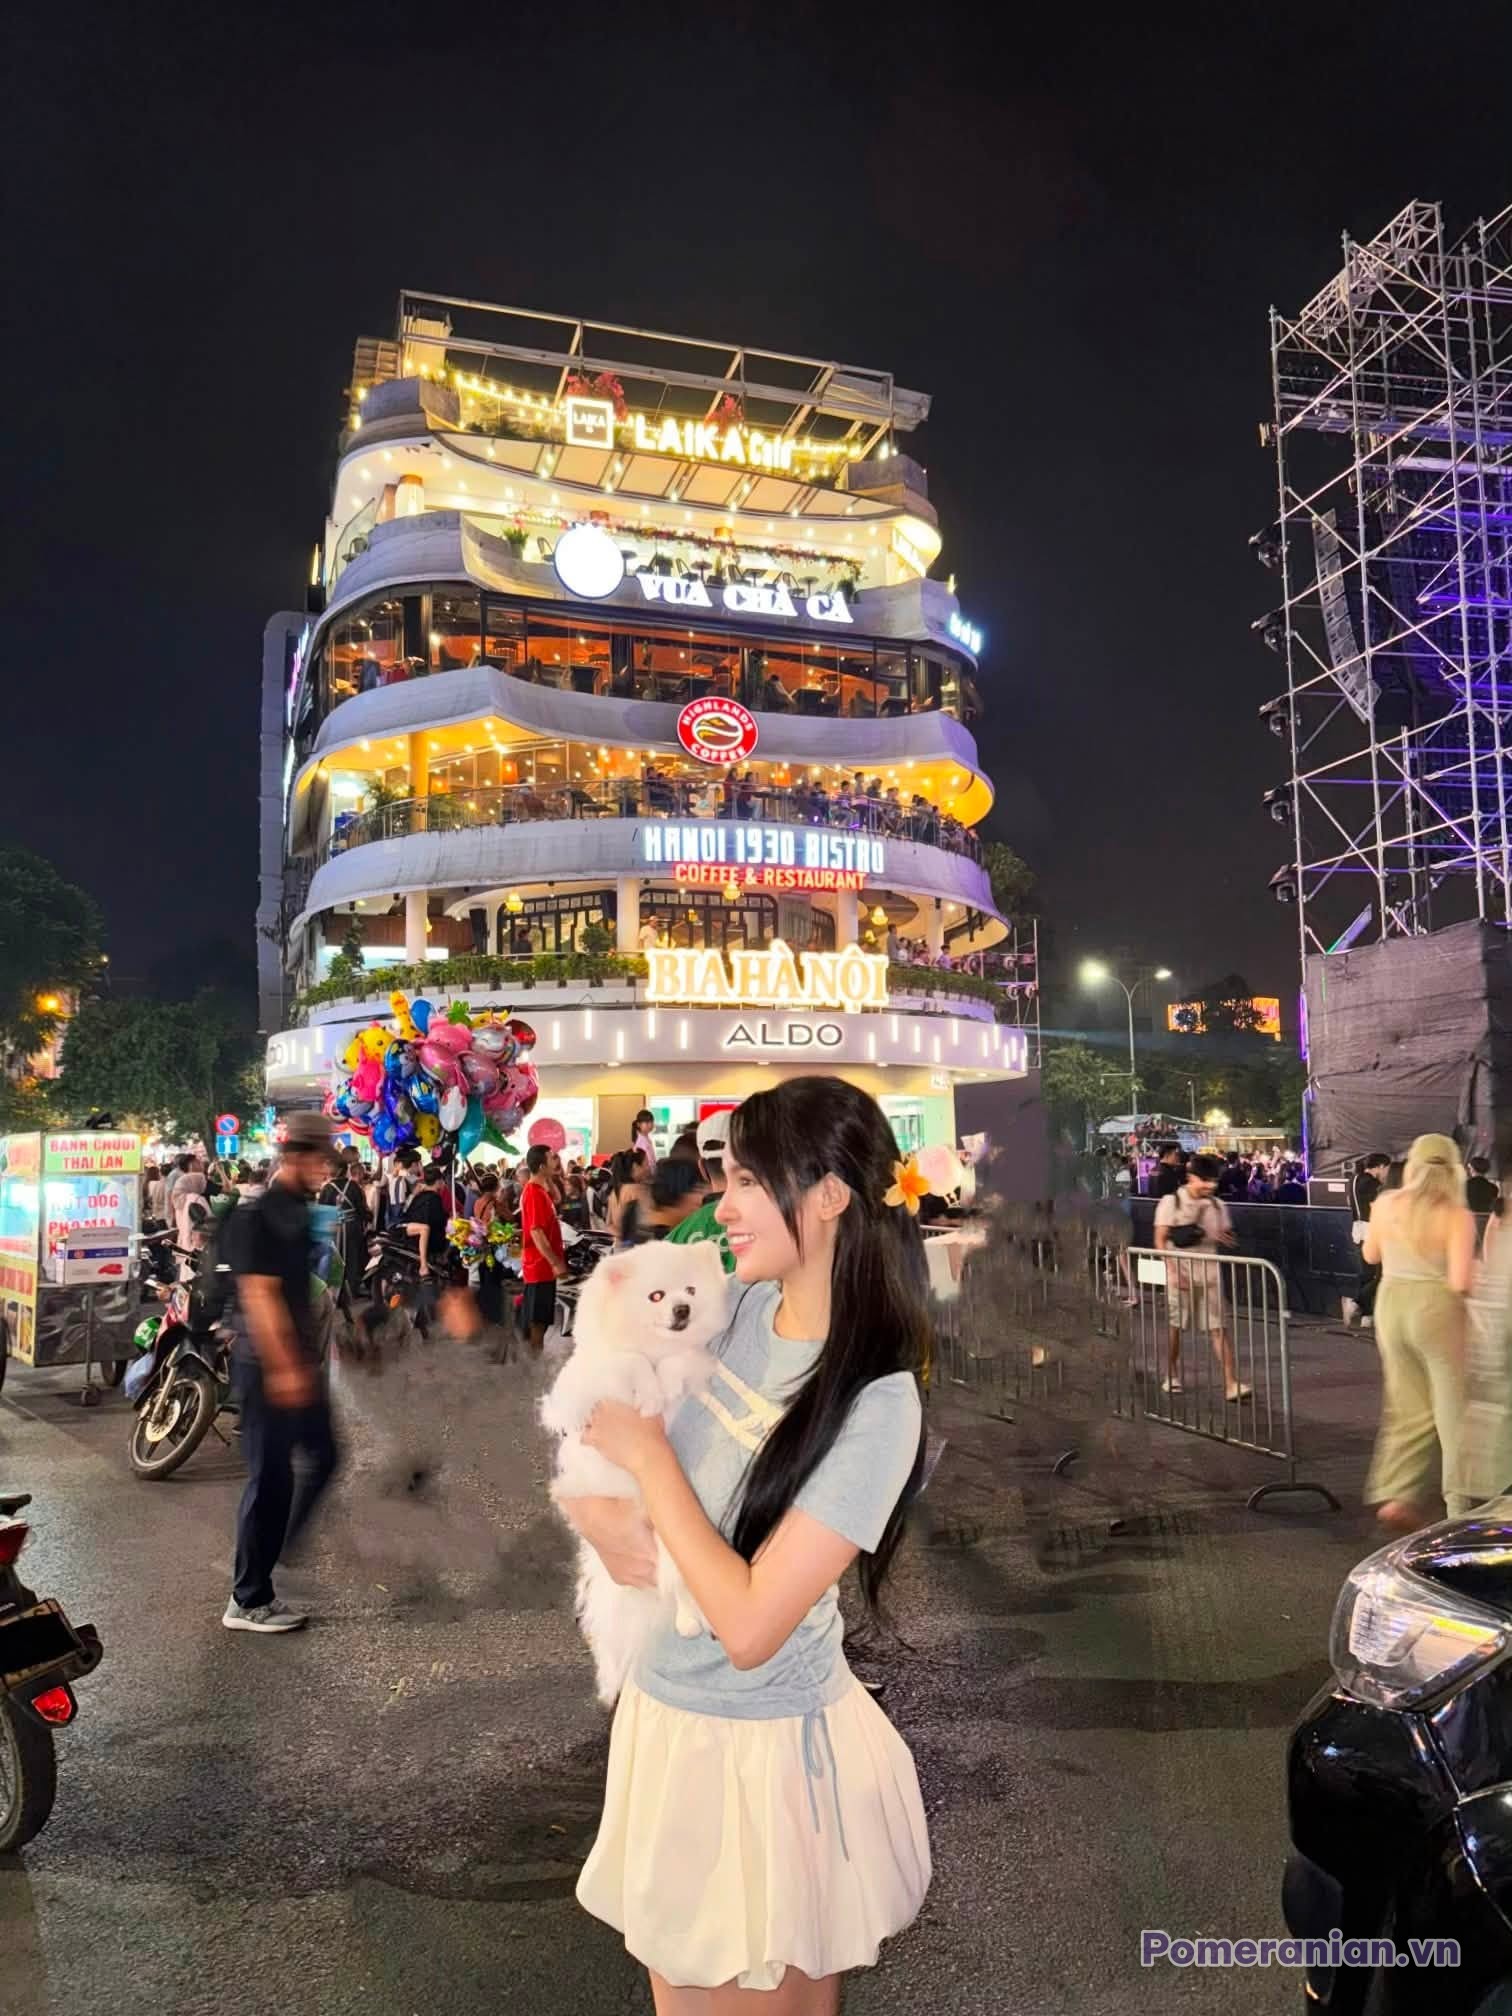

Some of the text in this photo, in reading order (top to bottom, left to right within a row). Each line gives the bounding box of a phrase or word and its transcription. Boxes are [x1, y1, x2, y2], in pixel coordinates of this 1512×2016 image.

[635, 413, 746, 465] LAIKA
[637, 572, 713, 607] VUA
[681, 701, 754, 732] HIGHLANDS
[690, 742, 747, 761] COFFEE
[644, 826, 885, 874] HANOI 1930 BISTRO
[676, 863, 866, 890] COFFEE & RESTAURANT
[646, 939, 889, 1013] BIA HÀ NỘI
[727, 1023, 843, 1046] ALDO
